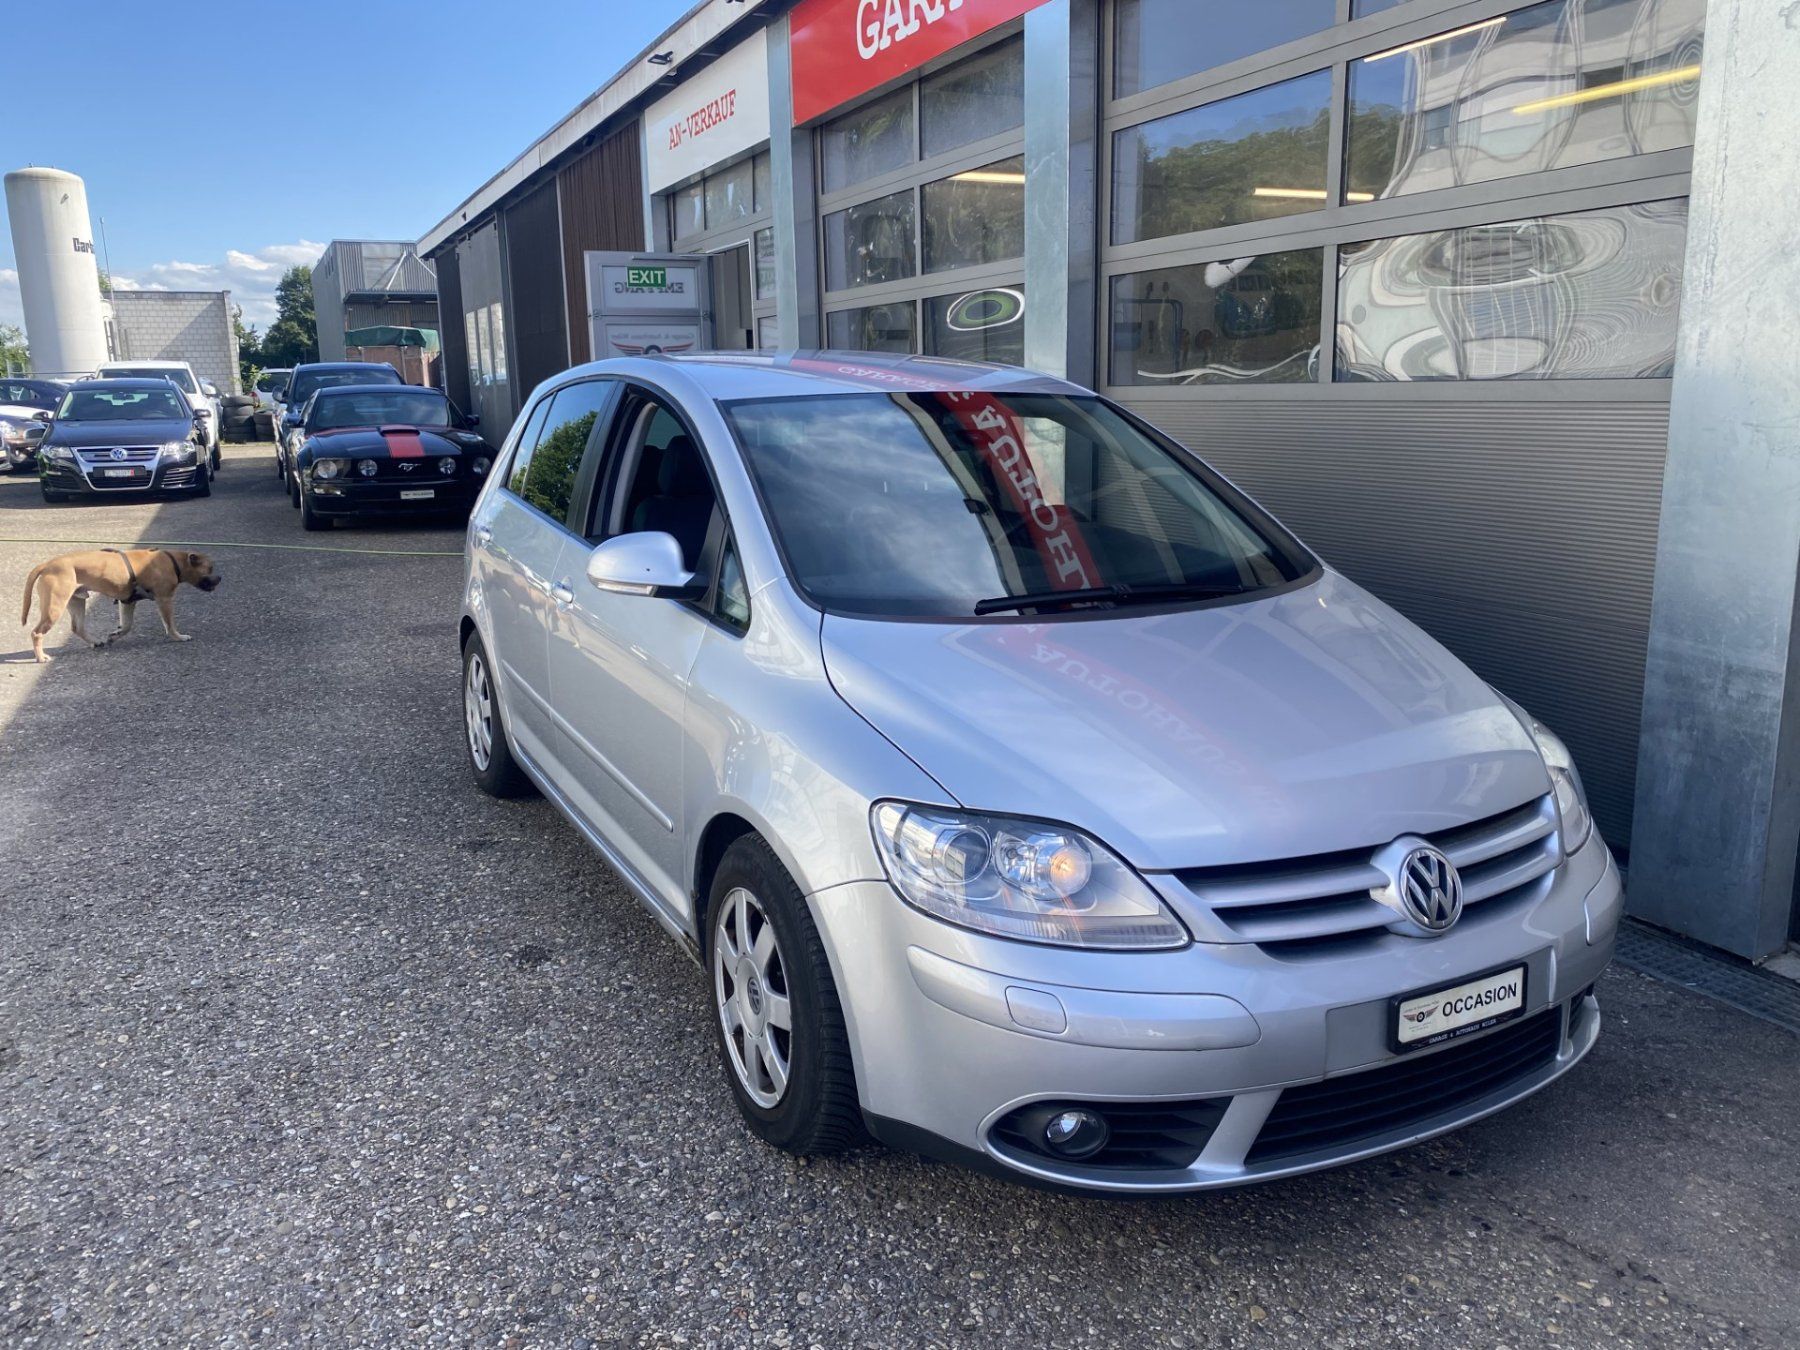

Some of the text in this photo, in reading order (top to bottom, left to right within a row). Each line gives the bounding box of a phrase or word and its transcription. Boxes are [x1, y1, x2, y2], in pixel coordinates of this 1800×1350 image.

[668, 88, 737, 151] AN-VERKAUF
[628, 269, 665, 285] EXIT
[1442, 982, 1517, 1017] OCCASION
